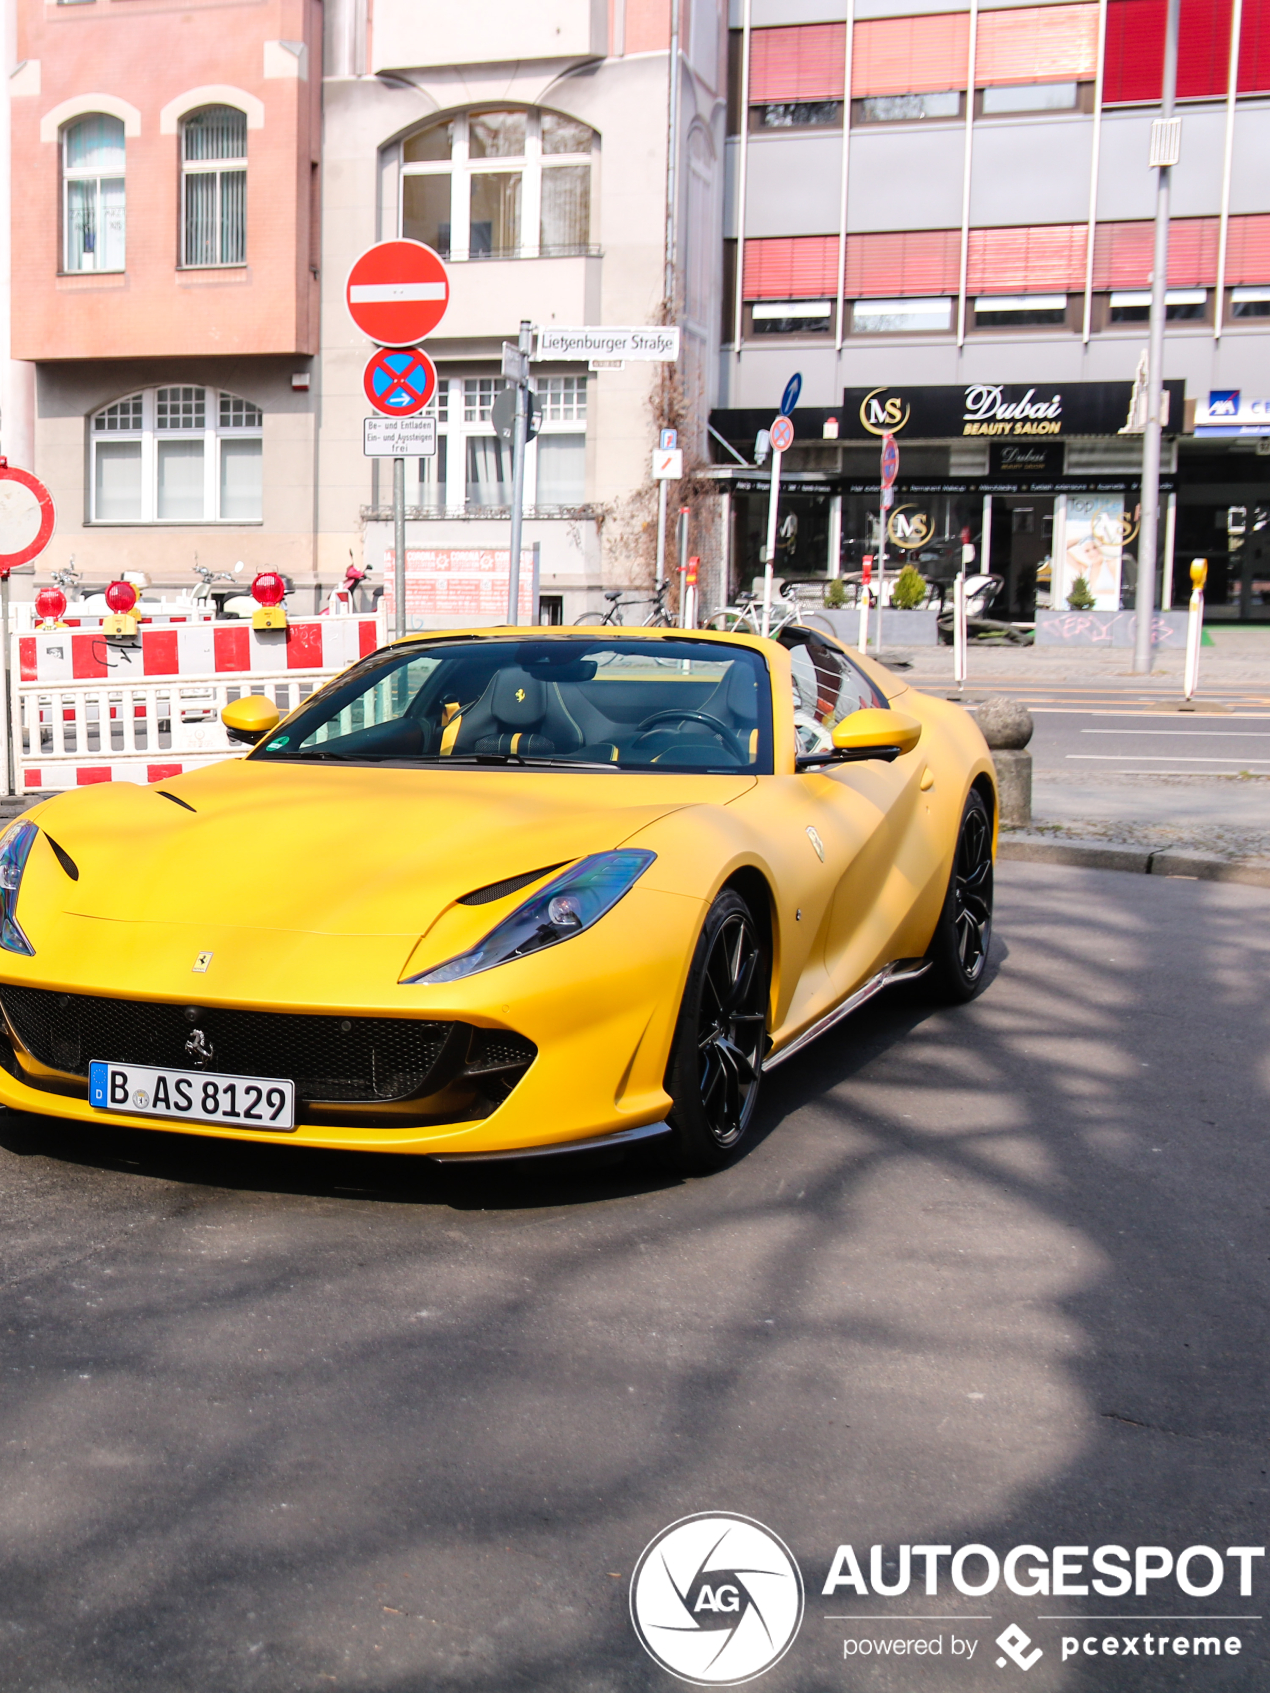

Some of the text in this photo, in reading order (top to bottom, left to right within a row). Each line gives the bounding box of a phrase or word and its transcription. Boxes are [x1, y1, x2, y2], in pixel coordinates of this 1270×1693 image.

[542, 334, 673, 353] Lietzenburger Straße
[963, 384, 1062, 420] Dubai
[1209, 400, 1236, 415] AXA
[868, 398, 902, 424] MS
[368, 421, 432, 430] Be- und Entladen
[963, 421, 1062, 436] BEAUTY SALON
[367, 433, 433, 443] Ein- und Aussteigen
[392, 443, 408, 452] frei
[1000, 446, 1047, 463] Dubai
[1068, 498, 1094, 514] Top
[895, 513, 927, 538] MS
[96, 1089, 103, 1099] D
[110, 1070, 286, 1121] B AS 8129
